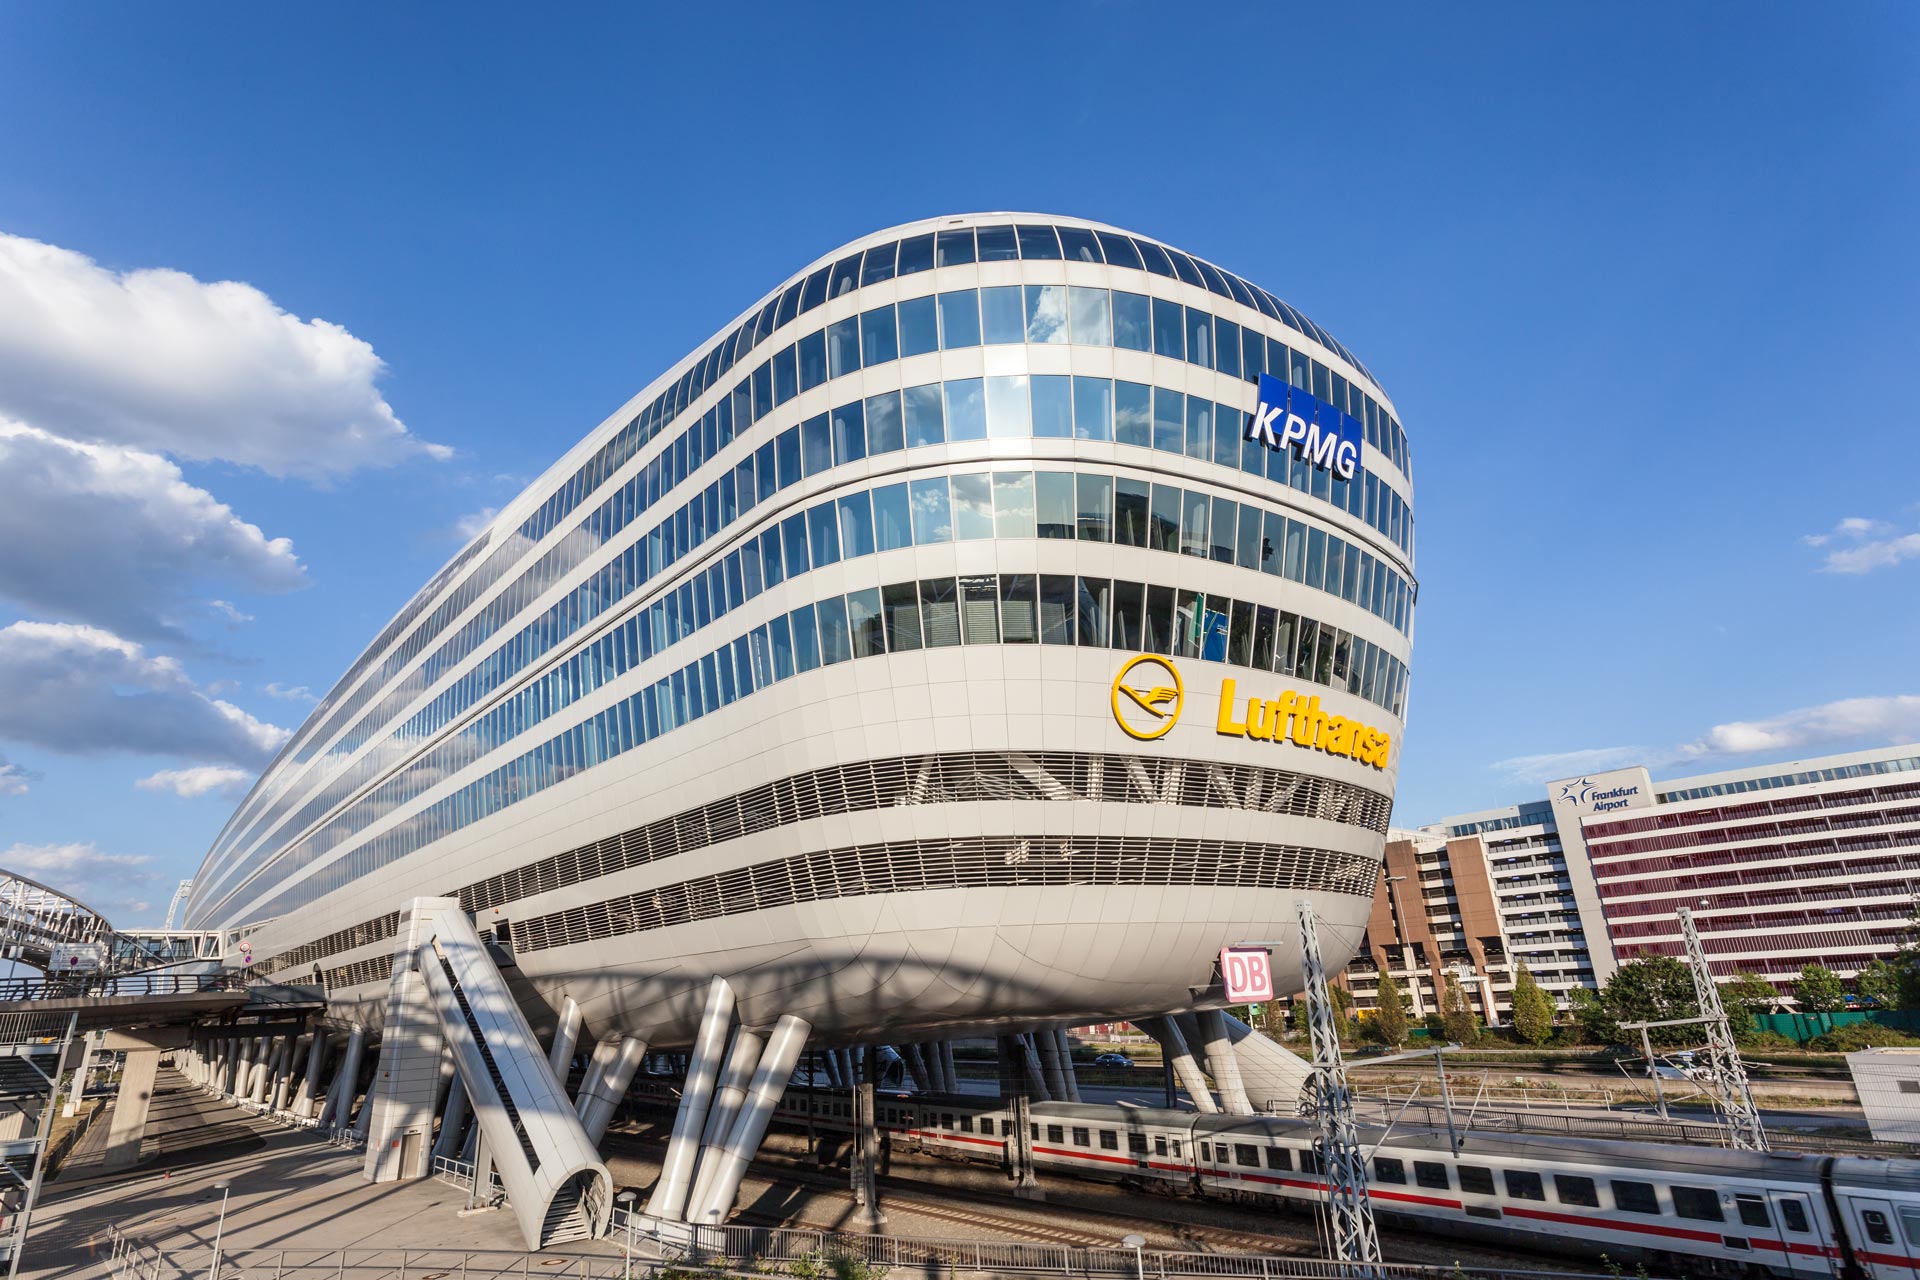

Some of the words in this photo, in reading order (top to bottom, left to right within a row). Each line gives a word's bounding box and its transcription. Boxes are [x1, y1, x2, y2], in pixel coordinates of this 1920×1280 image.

[1251, 401, 1357, 480] KPMG
[1216, 678, 1391, 769] Lufthansa
[1591, 785, 1639, 801] Frankfurt
[1593, 798, 1629, 812] Airport
[1228, 955, 1267, 993] DB
[1722, 1194, 1731, 1204] 2
